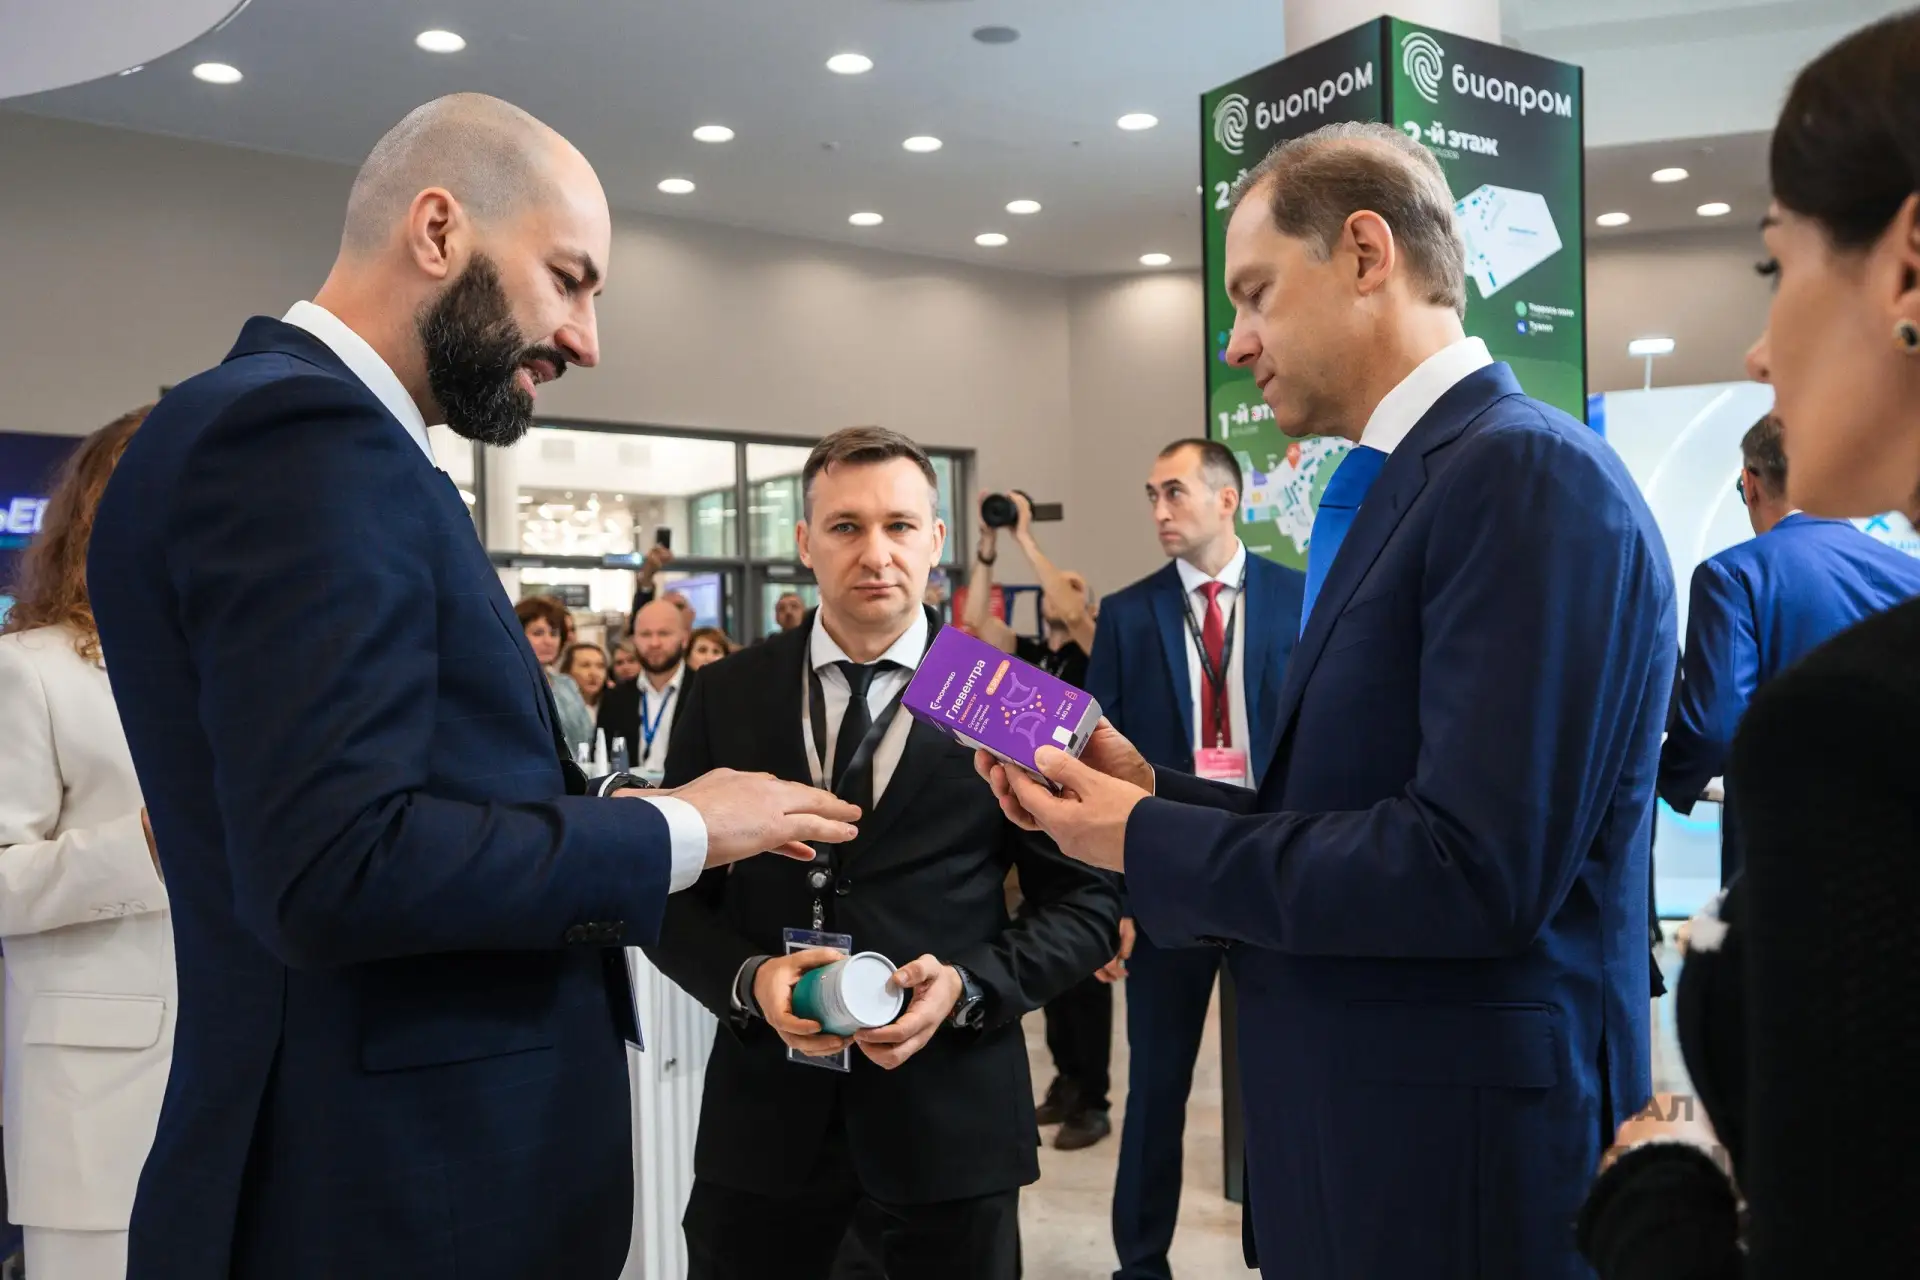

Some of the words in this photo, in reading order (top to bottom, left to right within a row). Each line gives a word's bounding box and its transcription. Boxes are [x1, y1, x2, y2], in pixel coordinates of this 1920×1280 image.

[1254, 61, 1373, 131] биопром
[1452, 63, 1572, 118] биопром
[1447, 129, 1500, 157] этаж
[1218, 402, 1249, 440] 1-й
[935, 671, 956, 703] PROMOMED
[945, 658, 987, 721] Глевентра
